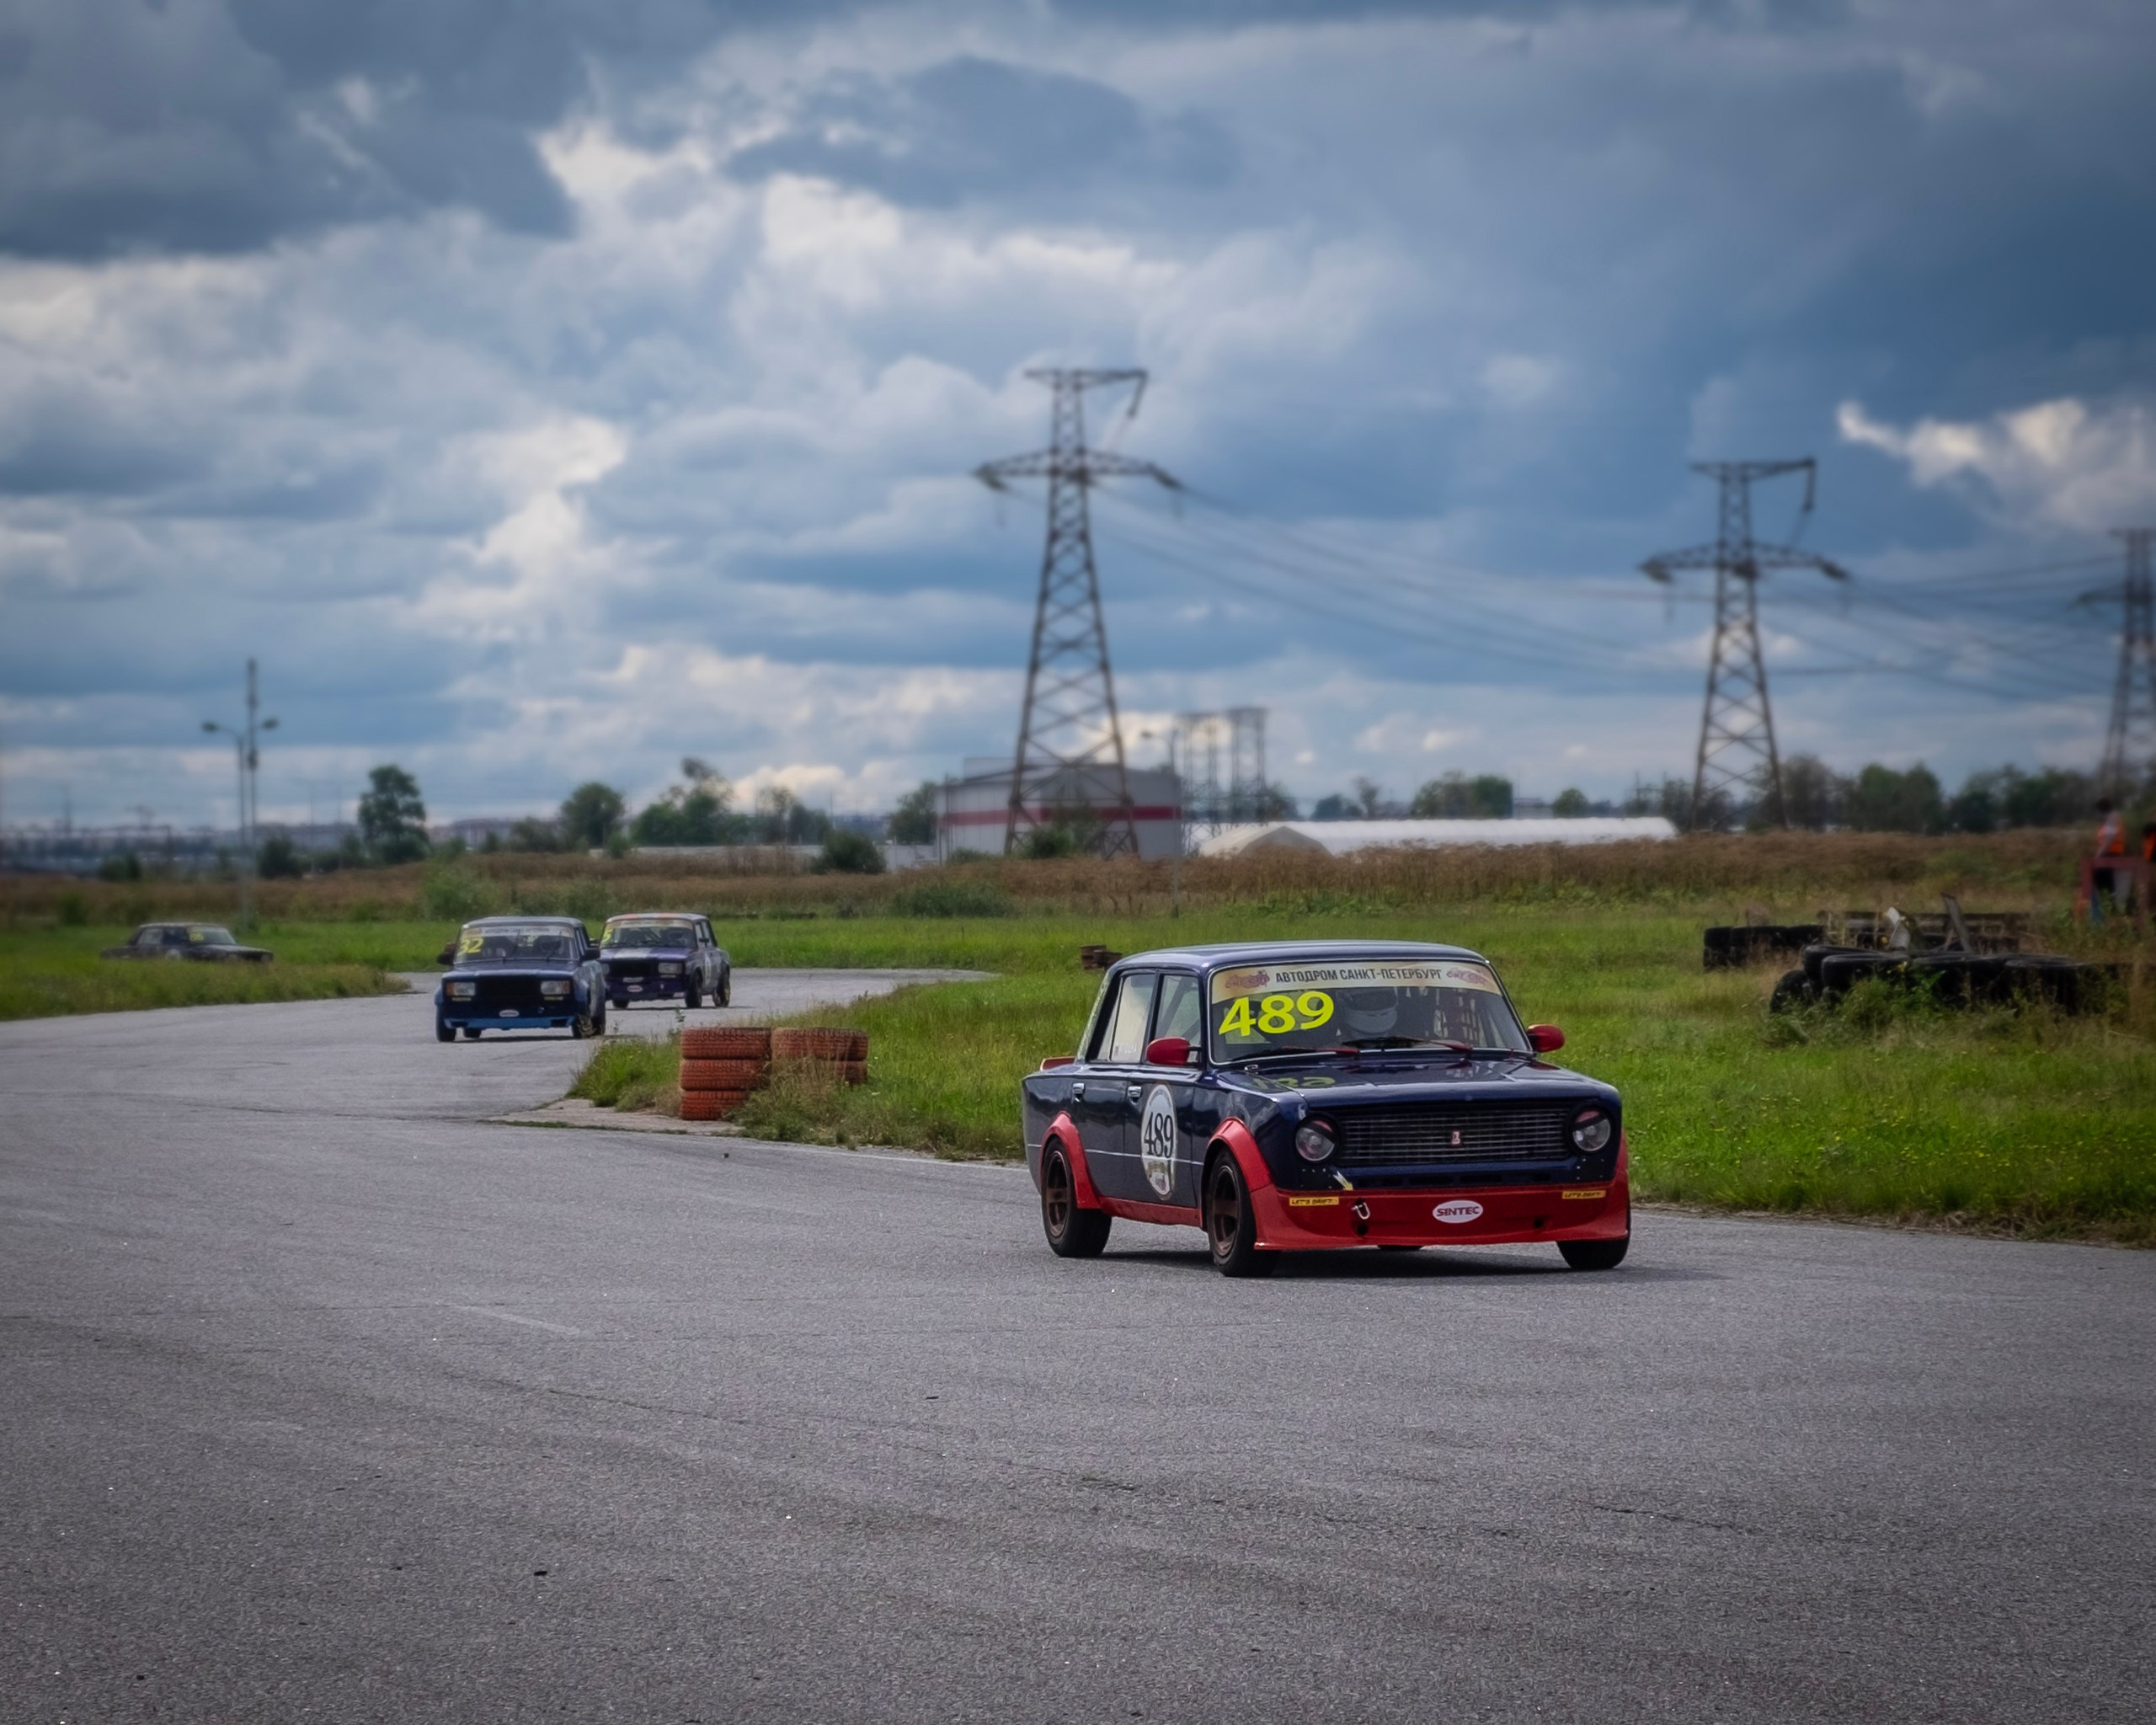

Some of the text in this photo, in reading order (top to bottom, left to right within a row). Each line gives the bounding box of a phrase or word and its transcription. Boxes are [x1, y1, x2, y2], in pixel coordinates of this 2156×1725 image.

[1276, 970, 1338, 983] АВТОДРОМ
[1340, 969, 1442, 980] САНКТ-ПЕТЕРБУРГ
[1218, 991, 1335, 1037] 489
[1144, 1112, 1174, 1158] 489
[1436, 1205, 1481, 1217] SINTEC
